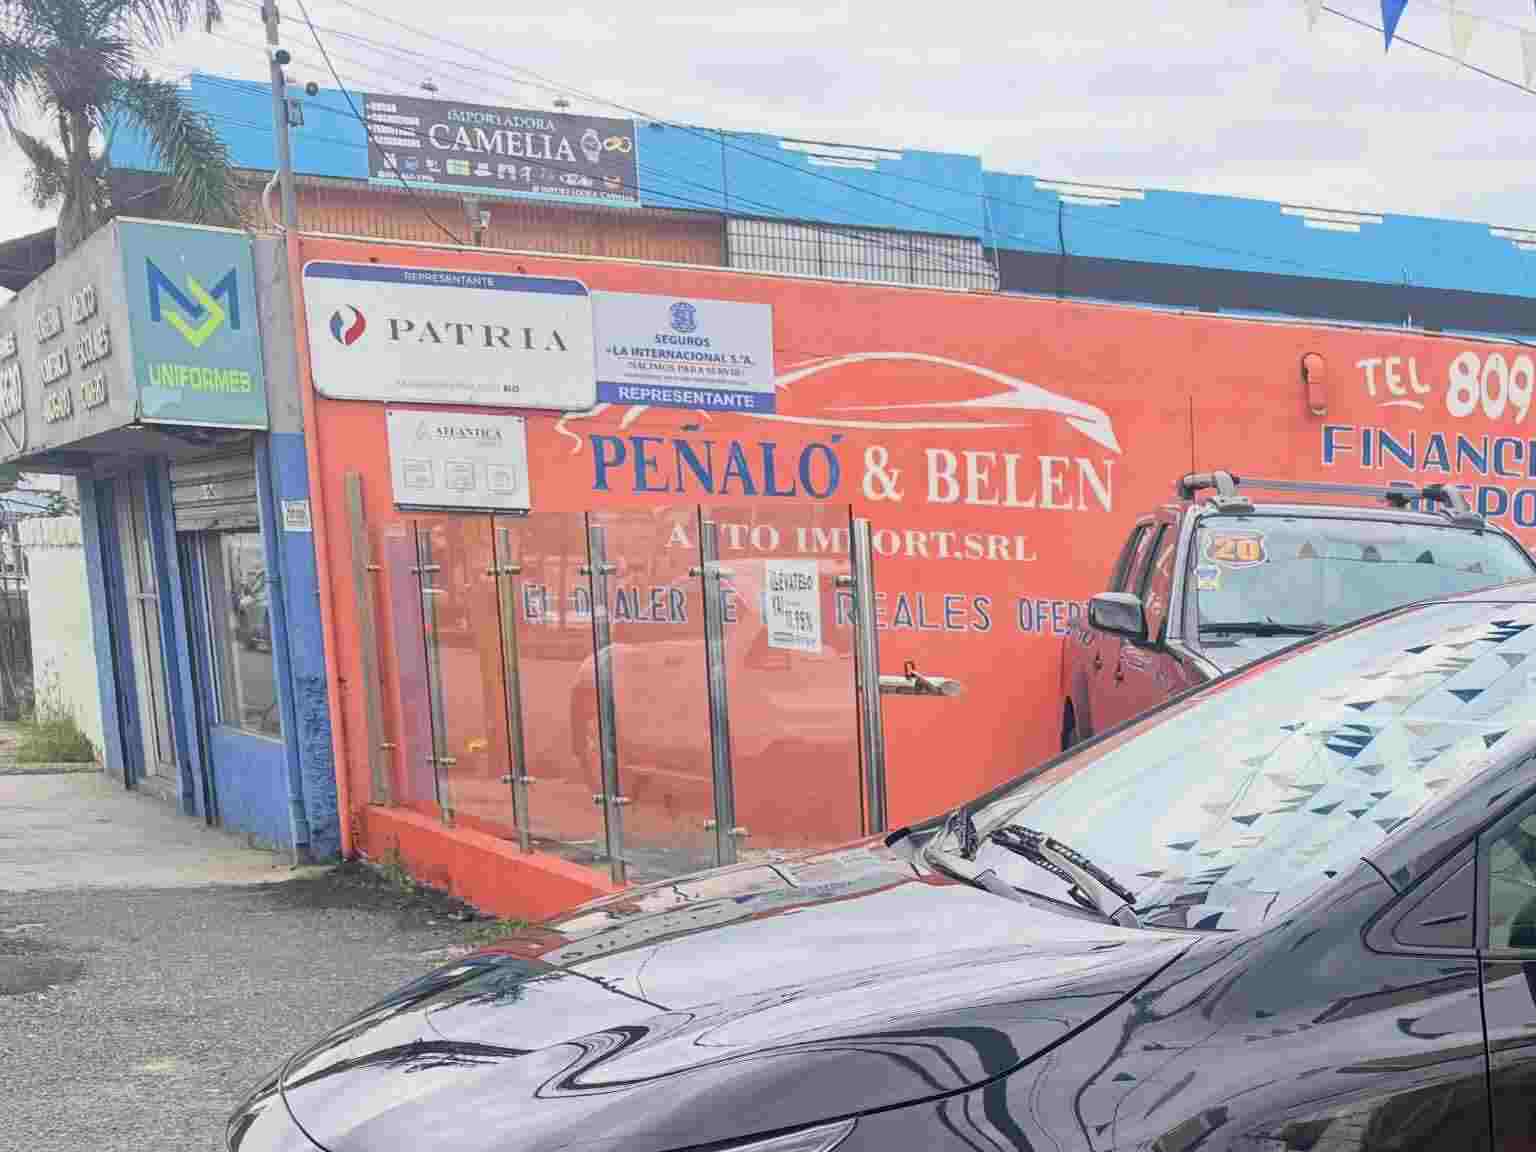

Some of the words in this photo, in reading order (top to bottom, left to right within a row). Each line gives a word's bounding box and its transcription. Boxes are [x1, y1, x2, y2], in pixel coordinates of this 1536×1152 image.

[448, 111, 556, 131] IMPORTADORA
[428, 123, 577, 162] CAMELIA
[403, 271, 496, 287] REPRESENTANTE
[386, 317, 568, 351] PATRIA
[655, 334, 712, 348] SEGUROS
[149, 362, 251, 394] UNIFORMES
[1355, 356, 1432, 397] TEL
[1445, 351, 1535, 424] 809
[617, 385, 756, 408] REPRESENTANTE
[862, 445, 904, 501] &
[925, 446, 1116, 513] BELEN
[663, 521, 781, 551] ATO
[796, 526, 1037, 562] IMORT.SRL
[573, 586, 688, 624] DALER
